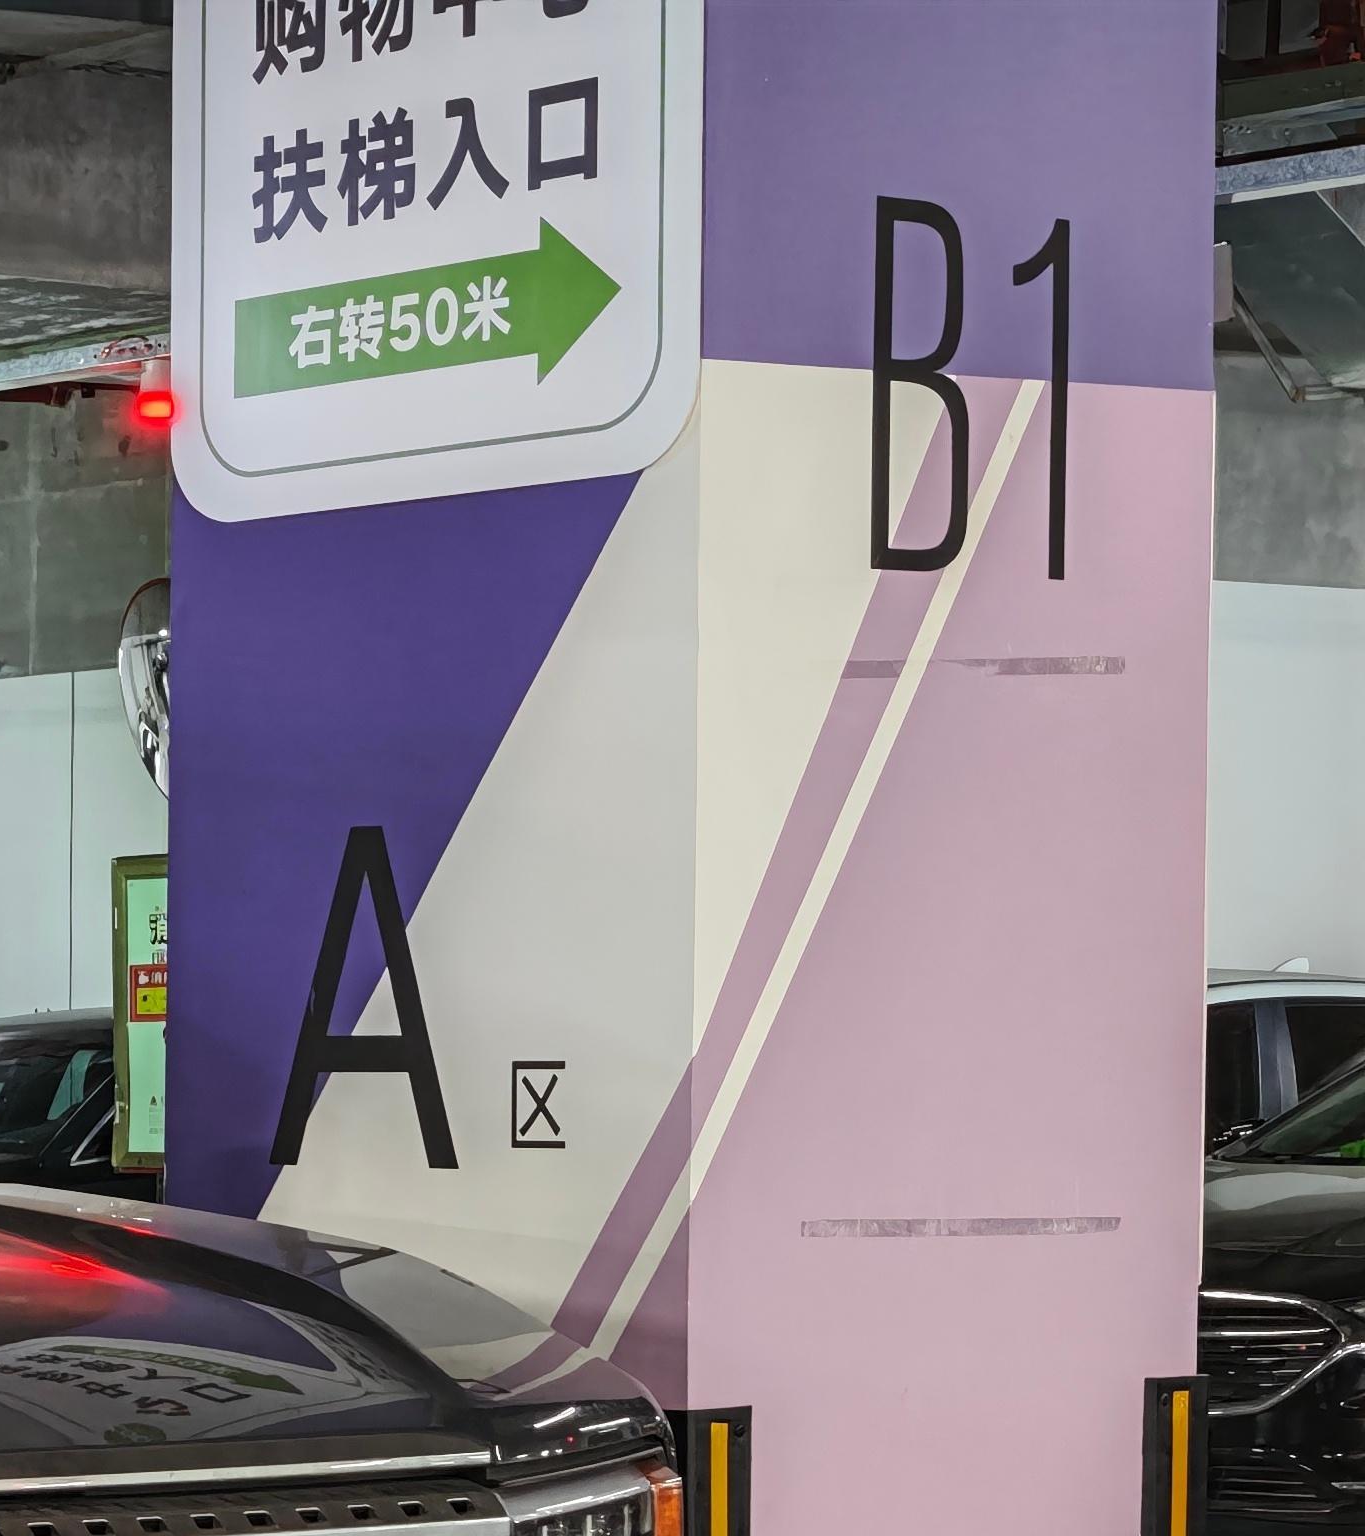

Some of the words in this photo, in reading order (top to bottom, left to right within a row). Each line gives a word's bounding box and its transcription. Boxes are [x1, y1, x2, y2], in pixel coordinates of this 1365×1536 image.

[252, 0, 589, 84] 购物
[252, 76, 598, 243] 扶梯入口
[288, 276, 512, 369] 右转50米
[870, 195, 1070, 581] B1
